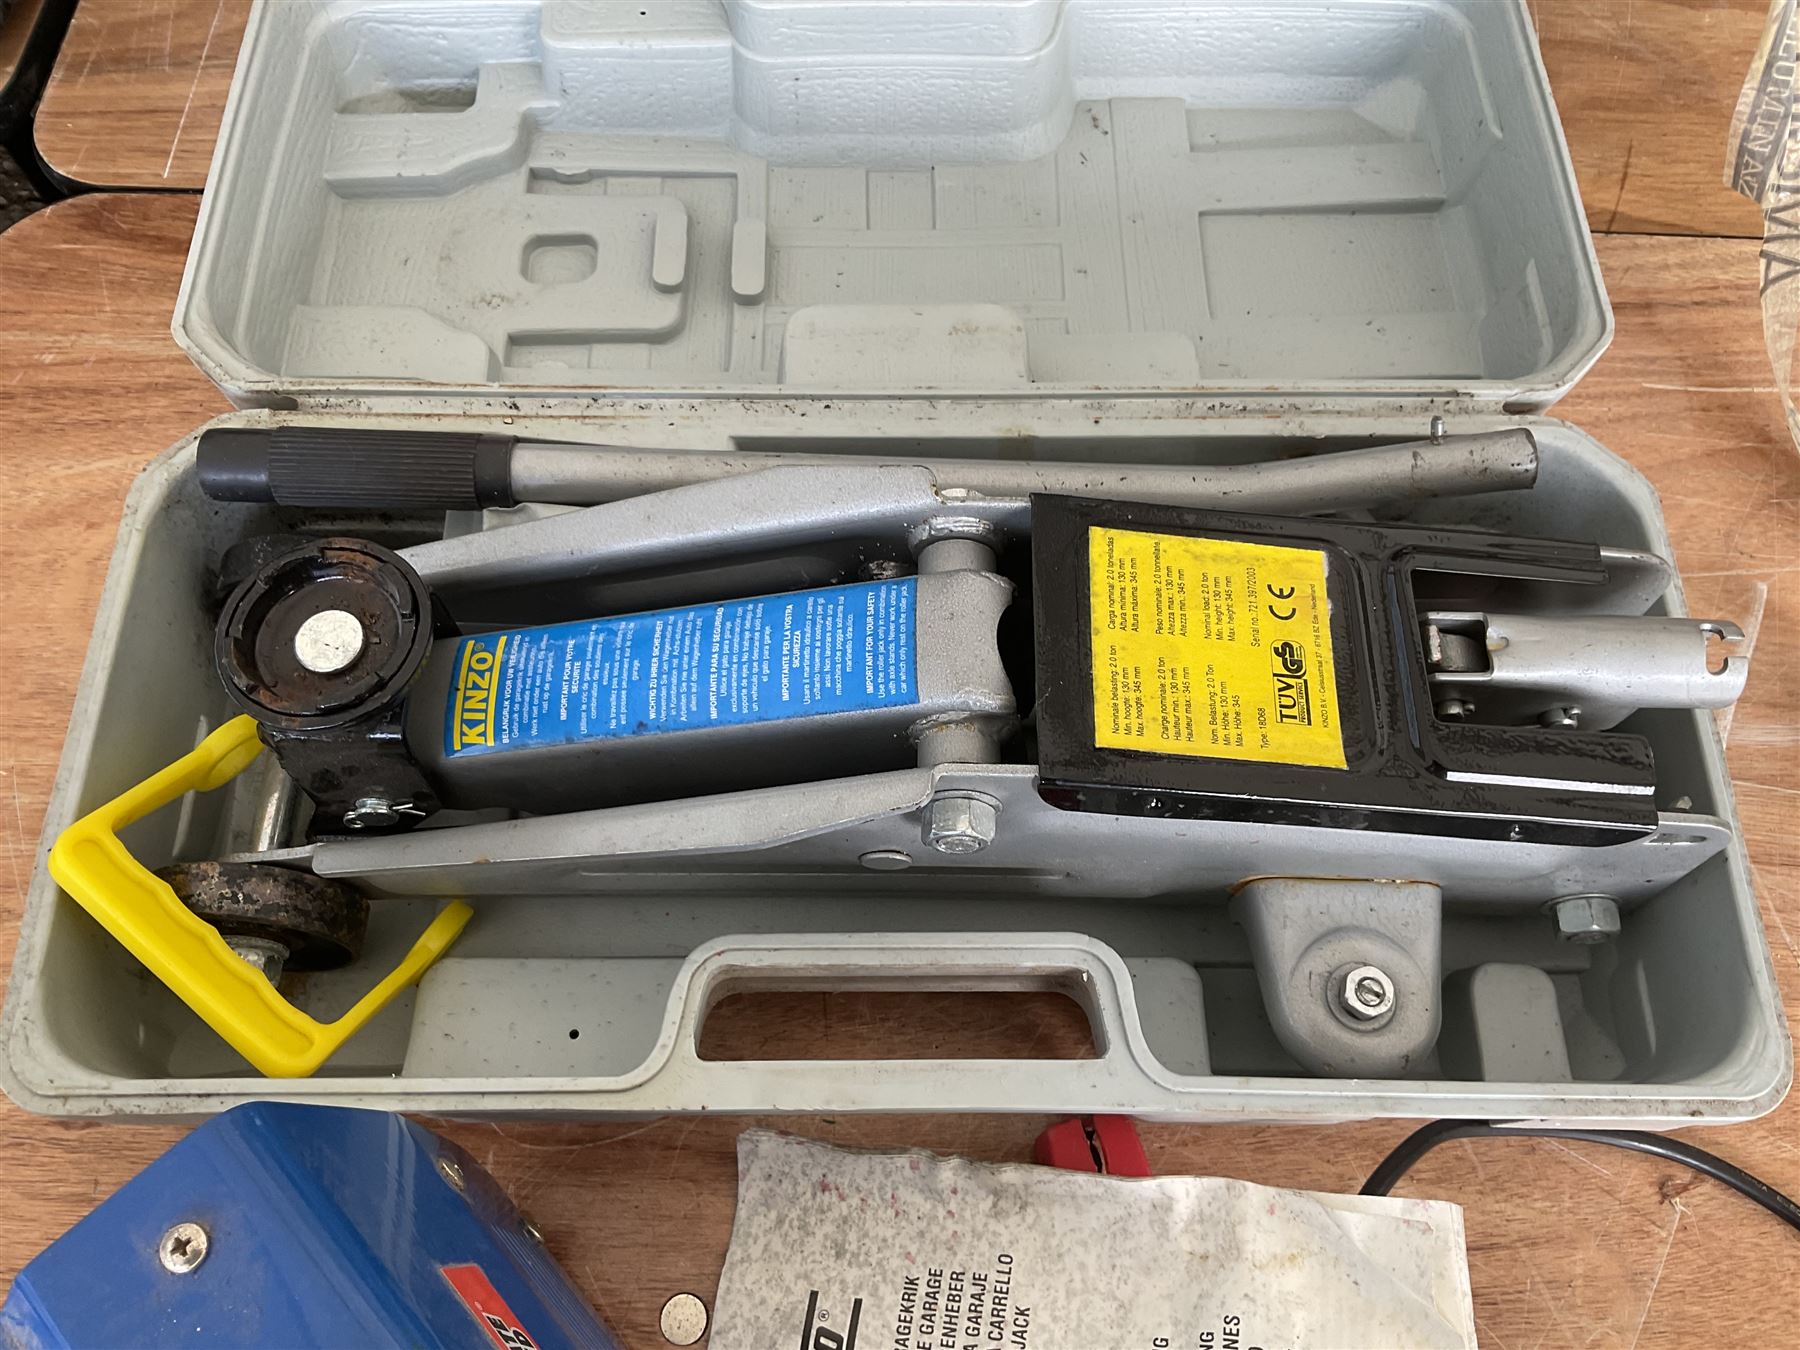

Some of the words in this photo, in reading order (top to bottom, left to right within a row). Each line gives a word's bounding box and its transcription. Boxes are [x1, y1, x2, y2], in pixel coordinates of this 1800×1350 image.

[867, 592, 875, 615] SAFETY
[1215, 604, 1224, 625] height:
[1226, 604, 1235, 624] height:
[1267, 584, 1296, 620] CE
[784, 604, 793, 630] VOSTRA
[1108, 610, 1117, 629] Carga
[1203, 613, 1212, 639] Nominal
[878, 626, 886, 639] only
[1250, 628, 1260, 647] Serial
[792, 630, 801, 668] SICUREZZA
[877, 640, 886, 653] jack
[1274, 642, 1303, 674] GS
[563, 661, 571, 680] POUR
[710, 653, 719, 672] PARA
[866, 652, 874, 694] IMPORTANT
[1158, 669, 1166, 680] 2.0
[462, 651, 494, 744] KINZO
[560, 681, 569, 720] IMPORTANT
[1159, 682, 1168, 713] nominale:
[1232, 695, 1240, 707] 345
[1277, 679, 1297, 723] TÜV
[1296, 682, 1304, 700] SERVICE
[1112, 703, 1120, 734] Nominale
[1124, 696, 1132, 720] hoogte:
[1135, 696, 1144, 719] hoogte:
[1209, 690, 1217, 725] Belastung:
[1258, 708, 1266, 729] 18D68
[1136, 721, 1144, 736] Max.
[1161, 716, 1170, 739] Charge
[1173, 715, 1181, 741] Hauteur
[1186, 716, 1194, 742] Hauteur
[1260, 732, 1270, 748] Type:
[919, 1268, 943, 1335] GARAGE
[941, 1271, 965, 1350] ENHEBER
[965, 1272, 988, 1337] GARAJE
[988, 1254, 1013, 1341] CARRELLO
[1011, 1304, 1030, 1349] JACK
